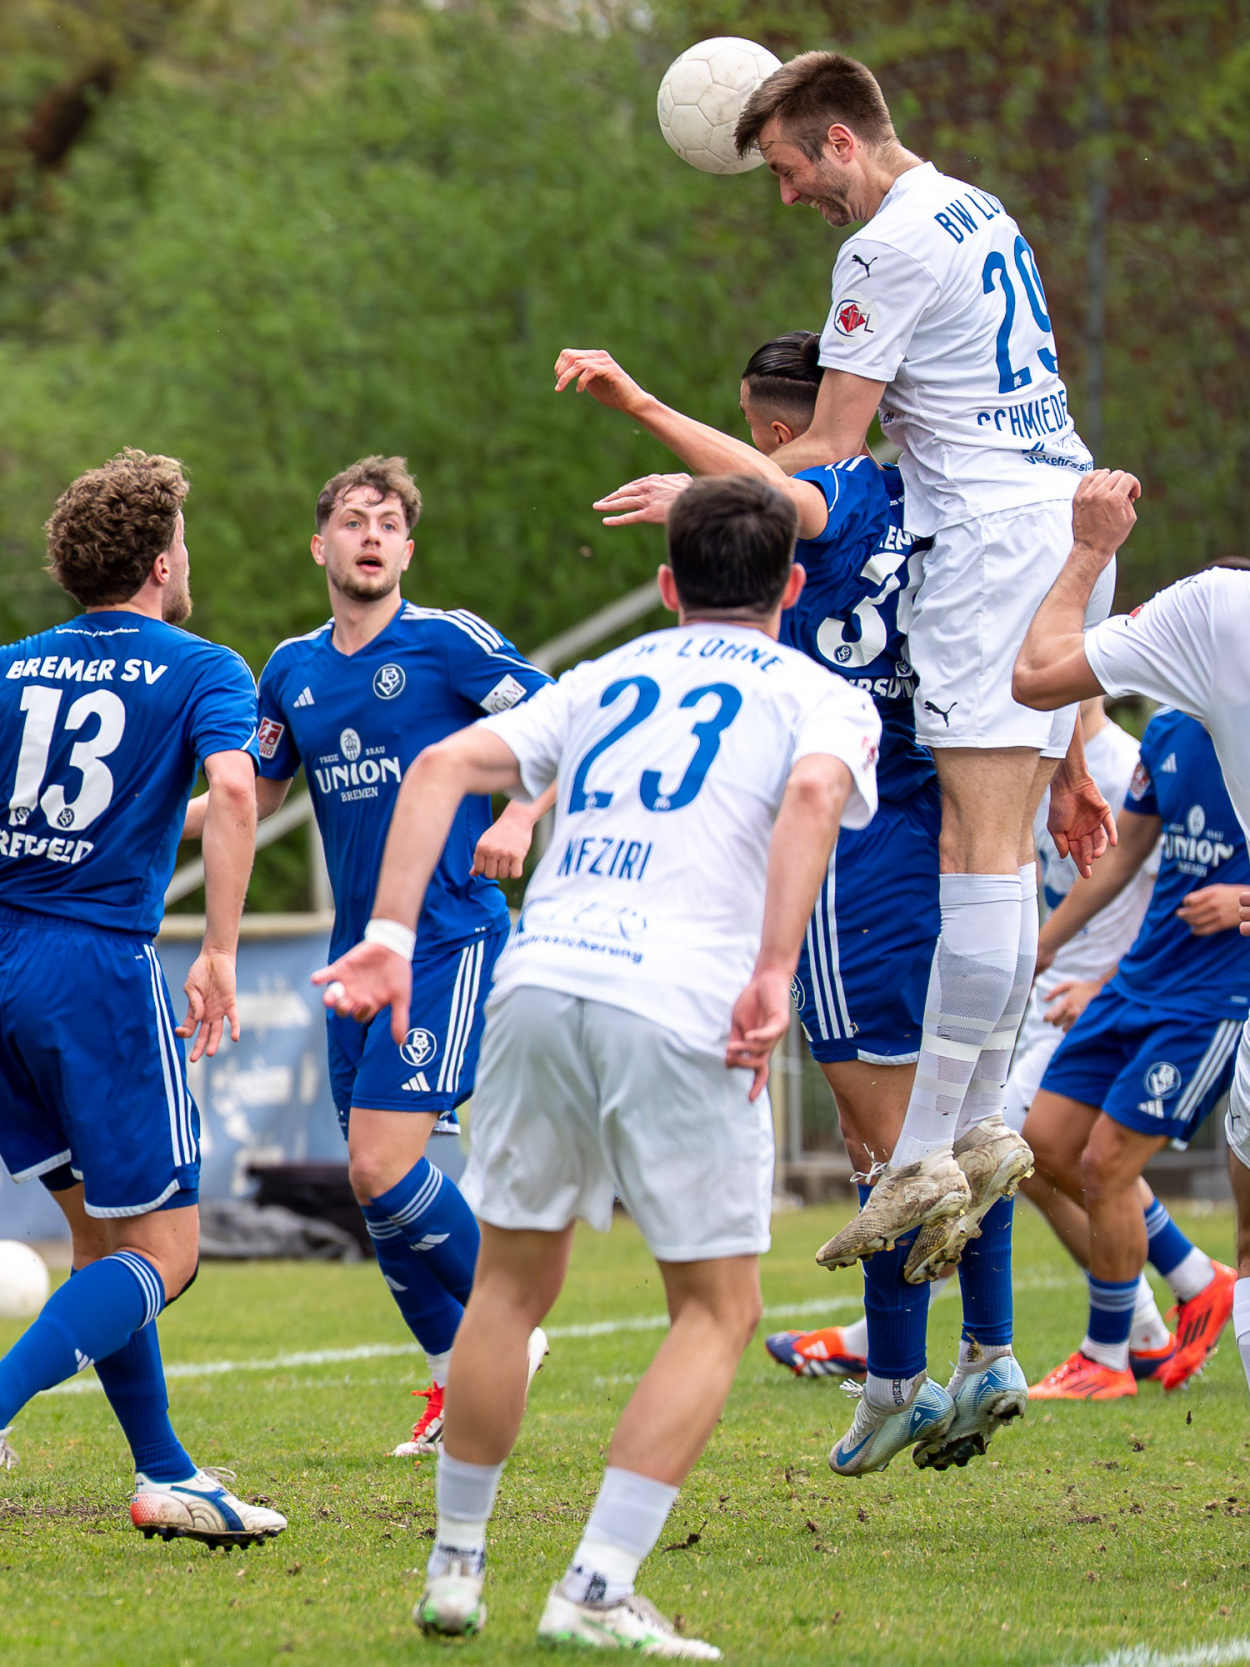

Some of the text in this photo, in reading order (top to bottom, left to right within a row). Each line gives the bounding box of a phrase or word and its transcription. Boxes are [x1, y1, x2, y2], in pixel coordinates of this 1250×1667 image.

[934, 199, 979, 244] BW
[982, 235, 1059, 395] 29
[5, 656, 168, 685] BREMER SV
[8, 684, 125, 831] 13
[568, 674, 743, 815] 23
[315, 756, 401, 794] UNION
[341, 787, 378, 802] BREMEN
